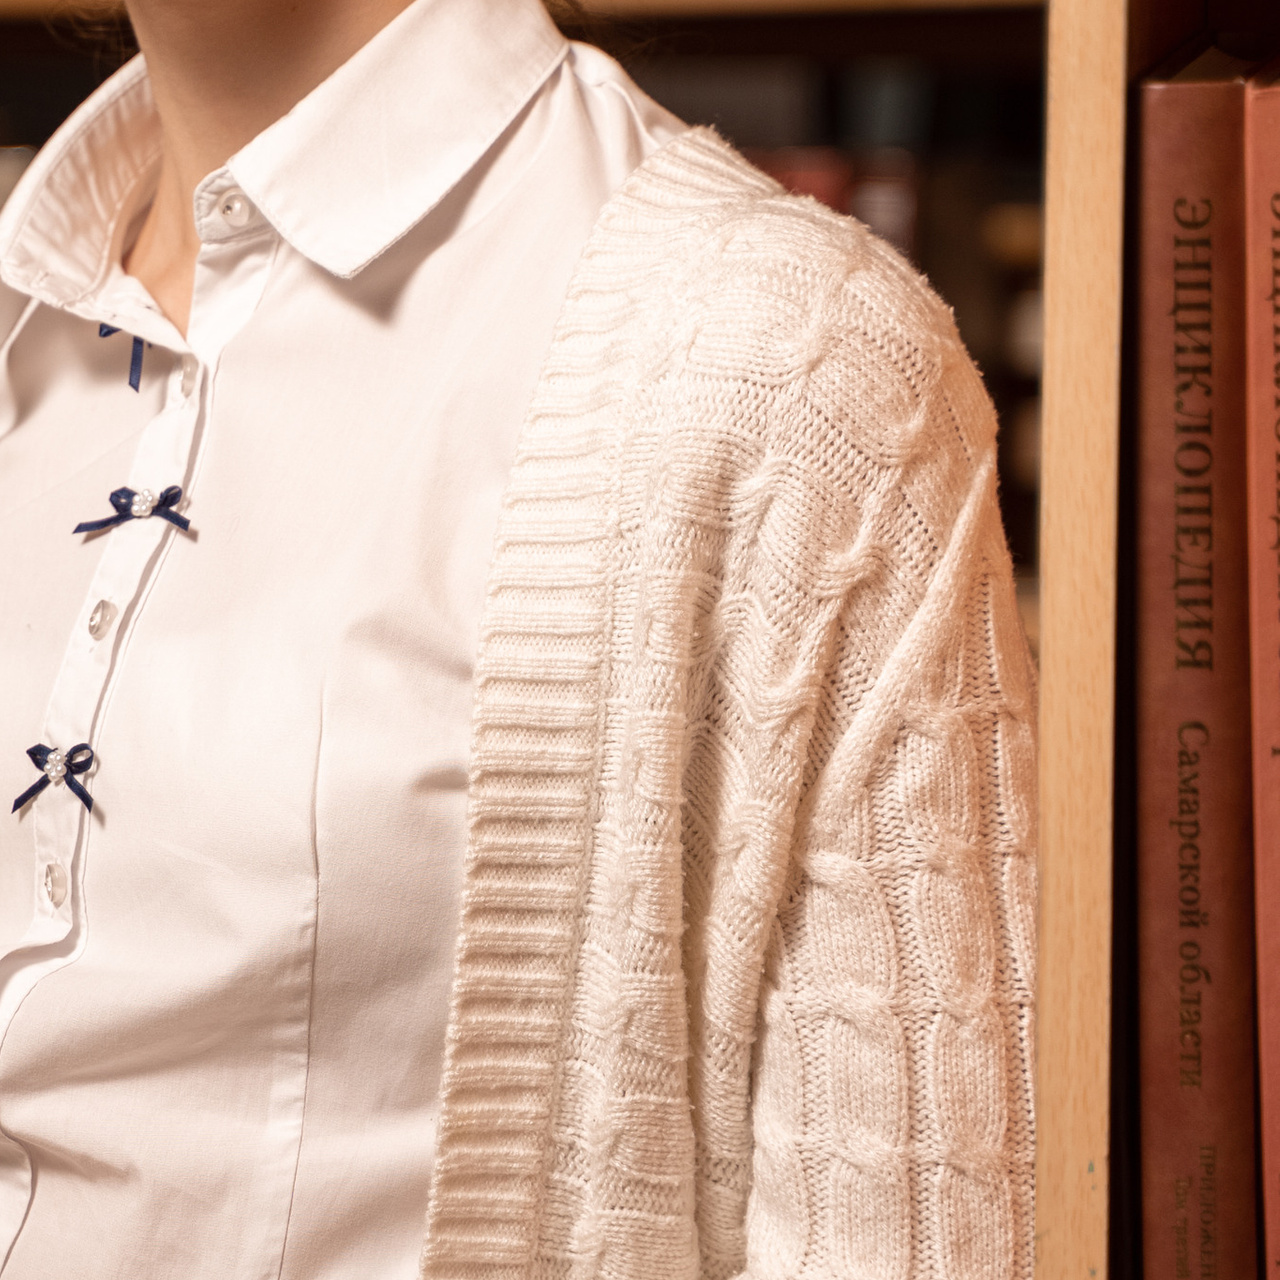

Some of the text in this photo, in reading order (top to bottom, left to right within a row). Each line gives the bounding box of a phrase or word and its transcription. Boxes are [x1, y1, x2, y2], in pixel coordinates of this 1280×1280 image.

[1167, 197, 1215, 1091] ЭНЦИКЛОПЕДИЯ Самарской области
